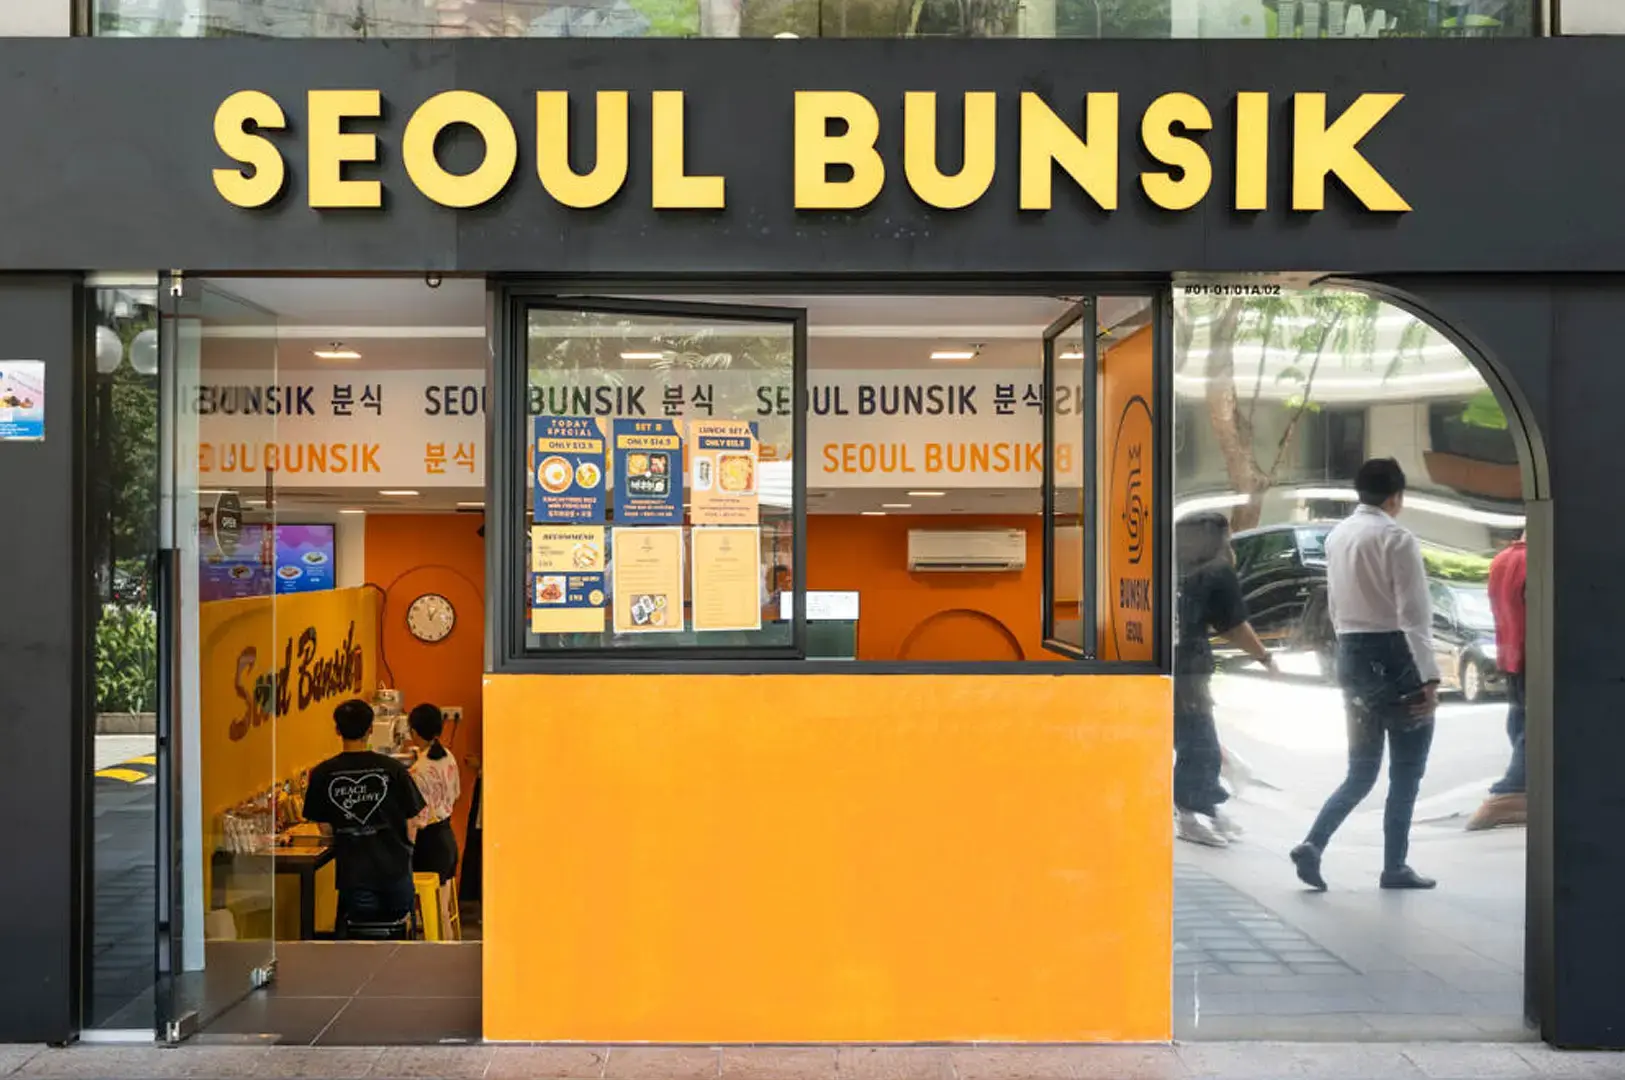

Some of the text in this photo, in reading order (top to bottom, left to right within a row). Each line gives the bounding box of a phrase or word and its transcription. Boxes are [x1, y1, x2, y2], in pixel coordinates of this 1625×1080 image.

[212, 89, 1412, 213] SEOUL BUNSIK
[331, 385, 383, 415] 분식
[529, 385, 647, 415] BUNSIK
[661, 384, 714, 416] 분식
[756, 386, 849, 415] SEUL
[858, 385, 977, 415] BUNSIK
[424, 442, 476, 474] 분식
[823, 443, 915, 473] SEOUL
[924, 443, 1043, 473] BUNSIK
